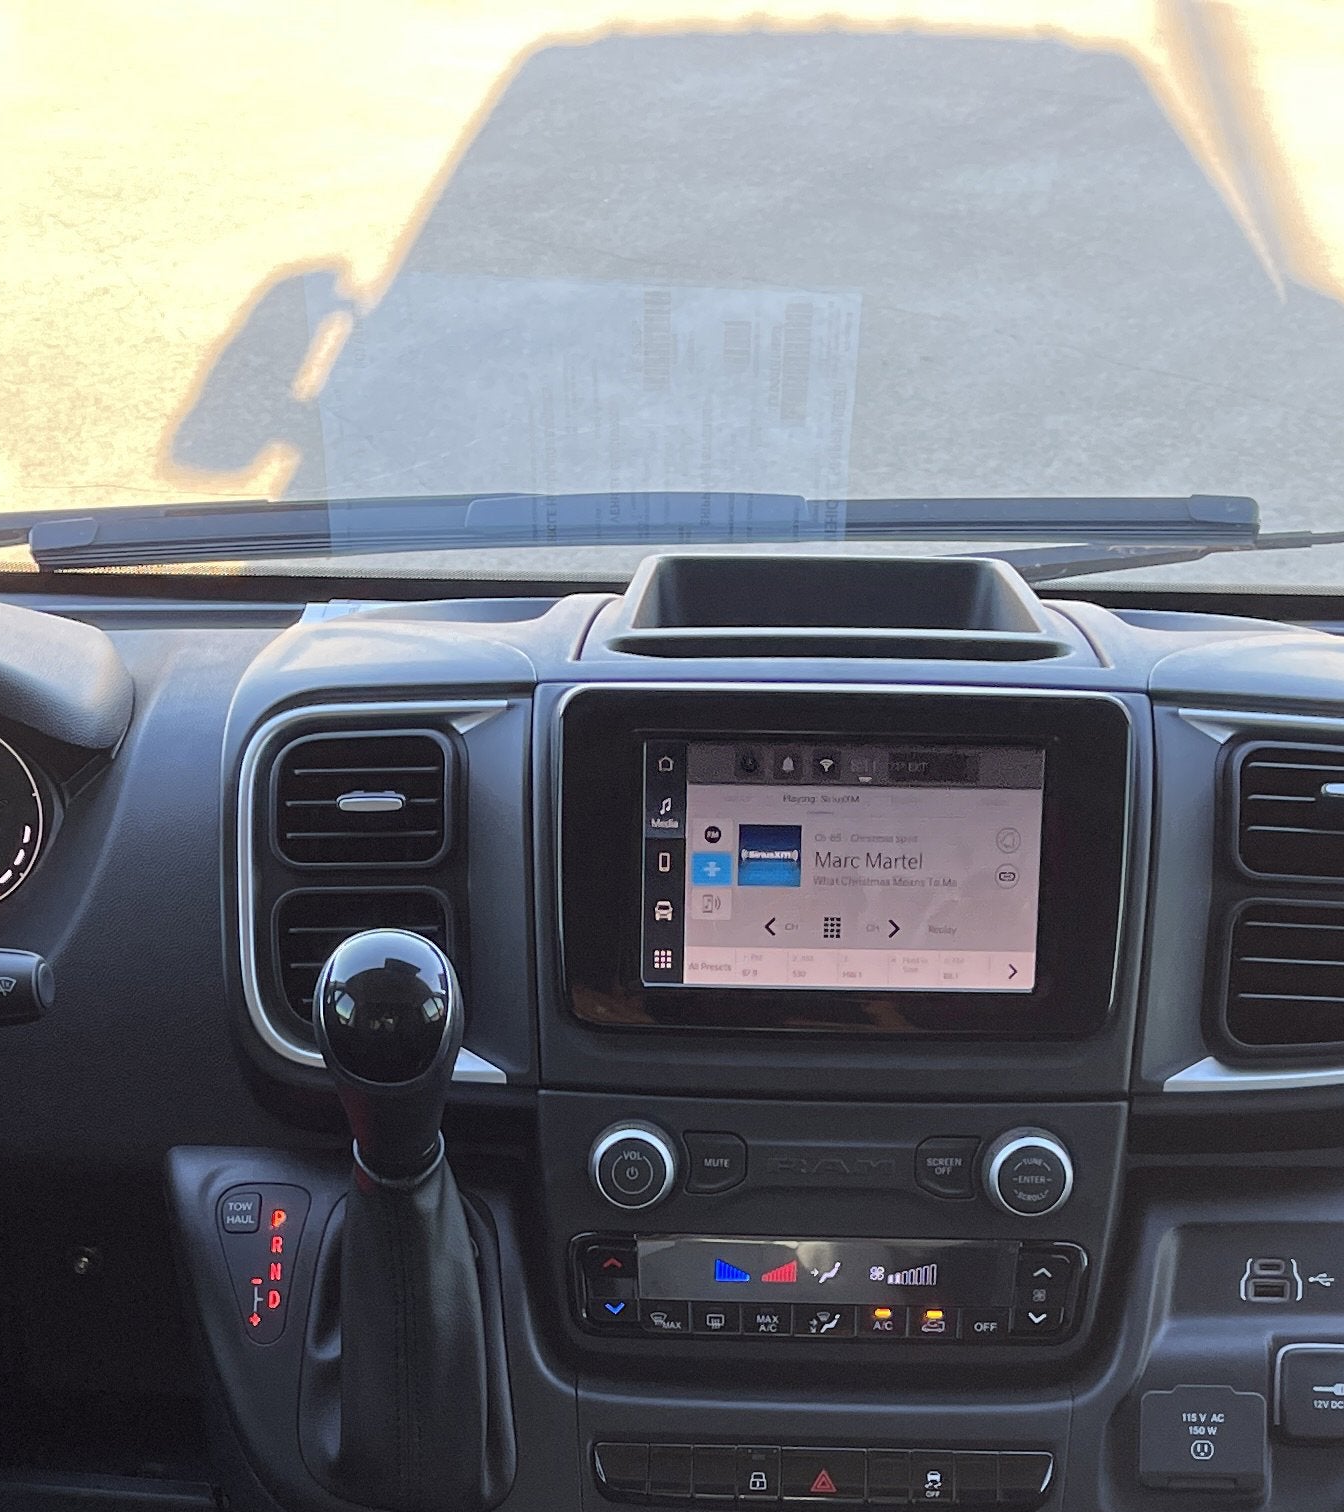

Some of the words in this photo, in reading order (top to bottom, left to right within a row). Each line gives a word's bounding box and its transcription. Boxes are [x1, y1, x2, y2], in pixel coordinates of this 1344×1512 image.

[814, 851, 861, 869] Marc
[865, 851, 924, 870] Martel
[622, 1149, 644, 1162] VOL
[703, 1157, 730, 1169] MUTE
[926, 1157, 963, 1167] SCREEN
[934, 1167, 953, 1175] OFF
[1018, 1175, 1047, 1184] ENTER
[227, 1201, 253, 1212] TOW
[226, 1214, 255, 1225] HAUL
[270, 1209, 287, 1228] P
[270, 1235, 283, 1254] R
[269, 1262, 282, 1281] N
[267, 1289, 281, 1309] D
[662, 1319, 682, 1331] MAX
[756, 1315, 780, 1326] MAX
[872, 1320, 894, 1332] A/C
[758, 1323, 778, 1334] A/C
[973, 1321, 998, 1333] OFF
[1313, 1400, 1329, 1410] 12V
[1330, 1400, 1344, 1410] DC
[1210, 1413, 1225, 1423] AC
[1188, 1426, 1206, 1435] 150
